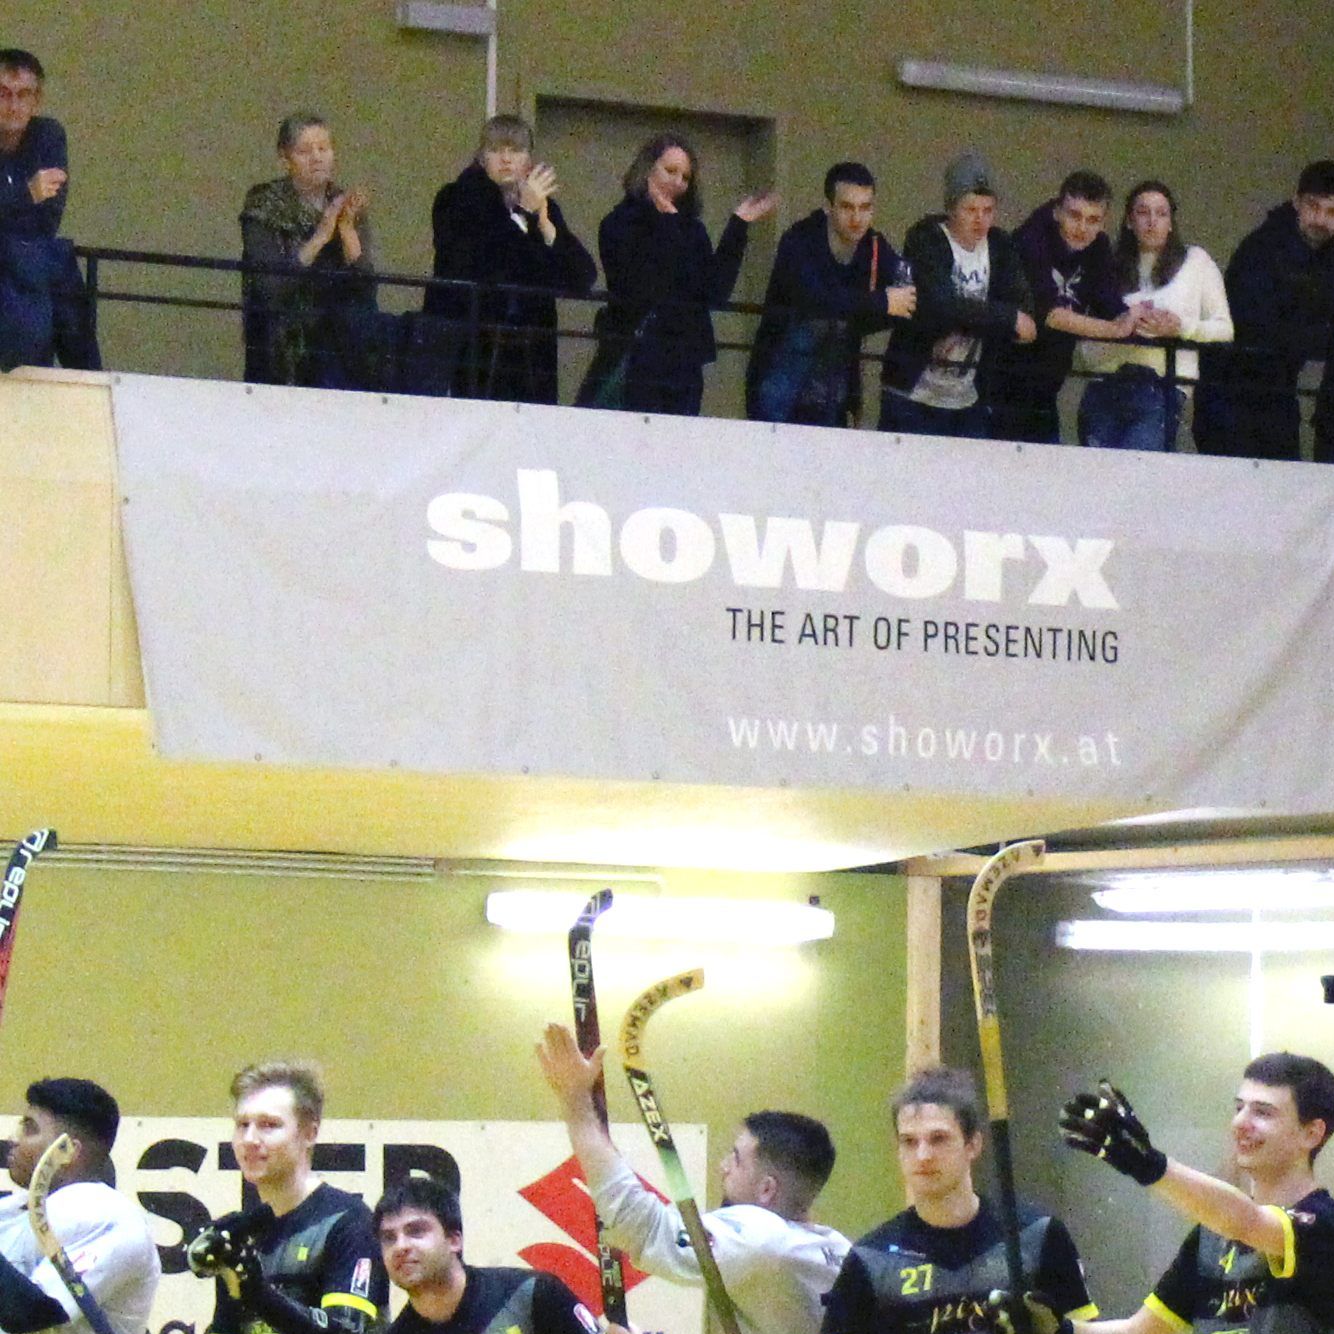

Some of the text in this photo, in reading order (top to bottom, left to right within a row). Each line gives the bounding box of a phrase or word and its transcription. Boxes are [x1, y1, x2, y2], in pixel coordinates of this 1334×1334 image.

[427, 469, 1119, 611] showorx
[726, 607, 1121, 665] THE ART OF PRESENTING
[728, 715, 1122, 767] www.showorx.at
[900, 1263, 933, 1296] 27
